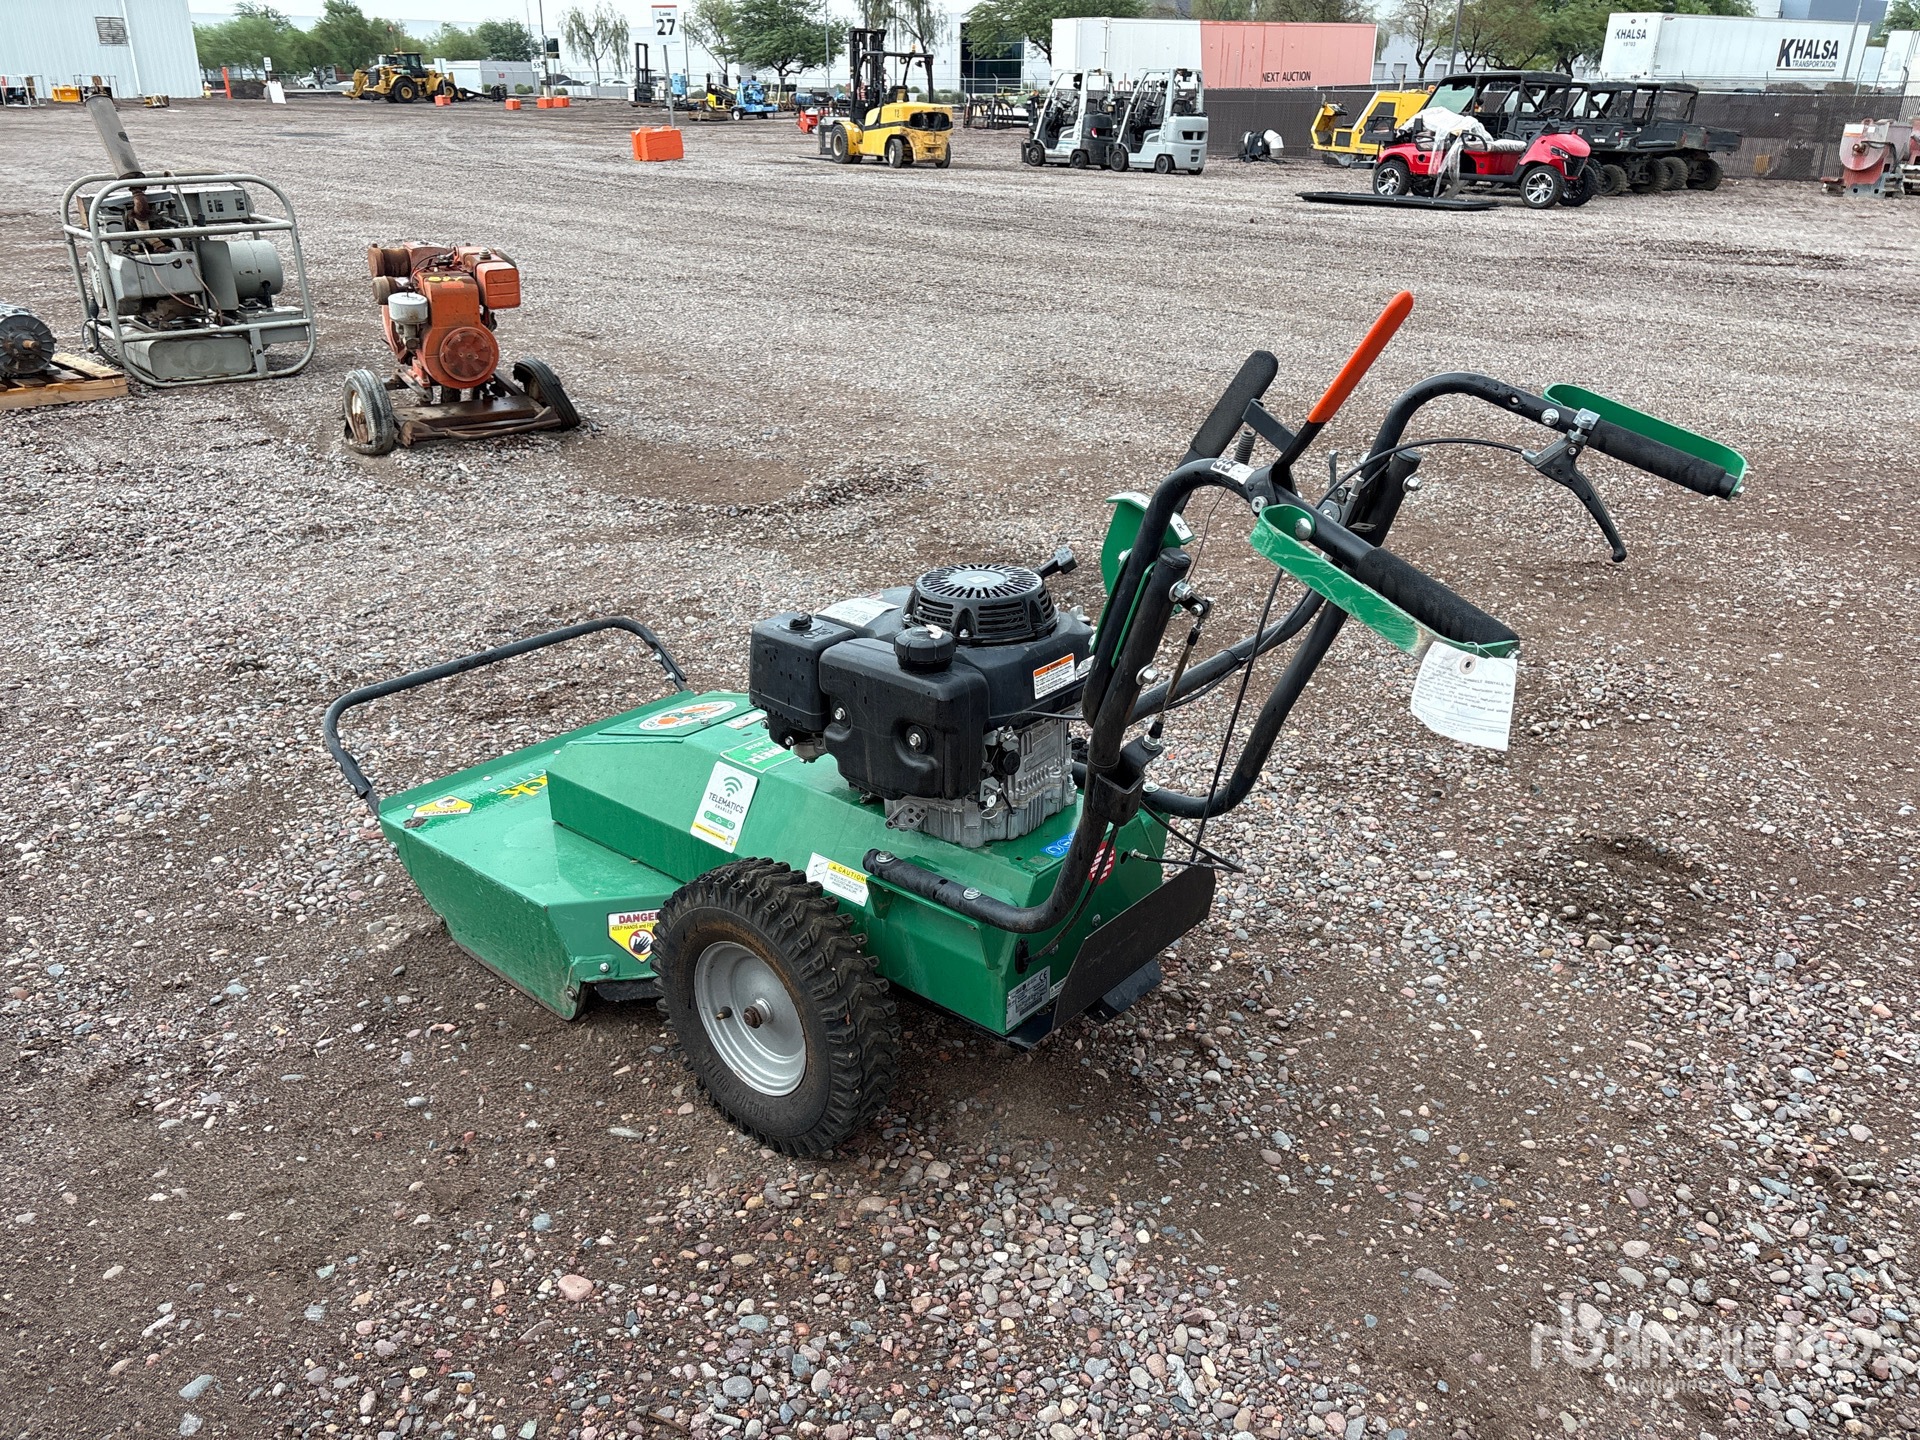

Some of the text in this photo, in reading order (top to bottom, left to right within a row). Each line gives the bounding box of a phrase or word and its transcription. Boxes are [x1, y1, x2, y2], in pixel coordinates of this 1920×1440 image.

[656, 19, 675, 35] 27
[1615, 29, 1646, 39] KHALSA
[1776, 38, 1838, 67] KHALSA
[1793, 60, 1837, 68] TRANSPORTATION
[1263, 71, 1311, 82] NEXT AUCTION
[709, 792, 744, 814] TELEMATICS
[715, 804, 732, 815] ENABLED
[838, 866, 865, 882] CAUTION
